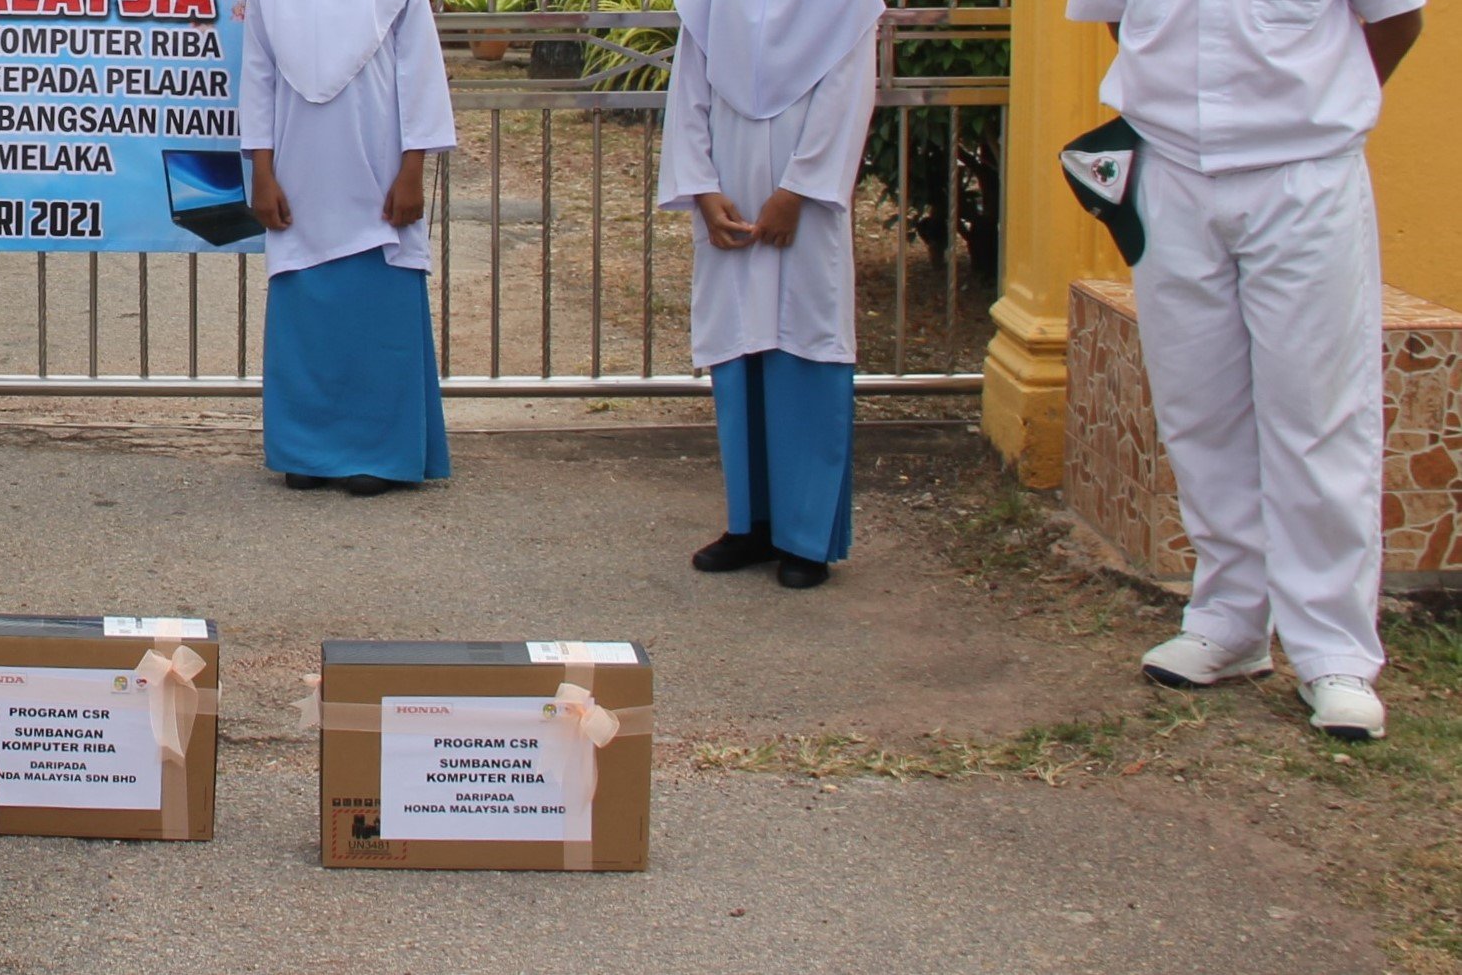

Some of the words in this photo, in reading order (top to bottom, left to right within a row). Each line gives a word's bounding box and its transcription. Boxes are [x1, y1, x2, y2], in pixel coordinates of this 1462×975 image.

[152, 31, 220, 58] RIBA
[107, 69, 227, 96] PELAJAR
[166, 108, 240, 136] NANI
[31, 202, 101, 236] 2021
[10, 708, 77, 718] PROGRAM
[83, 710, 109, 718] CSR
[396, 705, 450, 714] HONDA
[15, 728, 103, 738] SUMBANGAN
[2, 742, 78, 751] KOMPUTER
[84, 744, 115, 752] RIBA
[435, 739, 504, 747] PROGRAM
[510, 739, 537, 748] CSR
[31, 762, 86, 770] DARIPADA
[440, 759, 531, 768] SUMBANGAN
[25, 773, 81, 781] MALAYSIA
[427, 774, 505, 782] KOMPUTER
[512, 774, 544, 783] RIBA
[348, 840, 390, 850] UN3481
